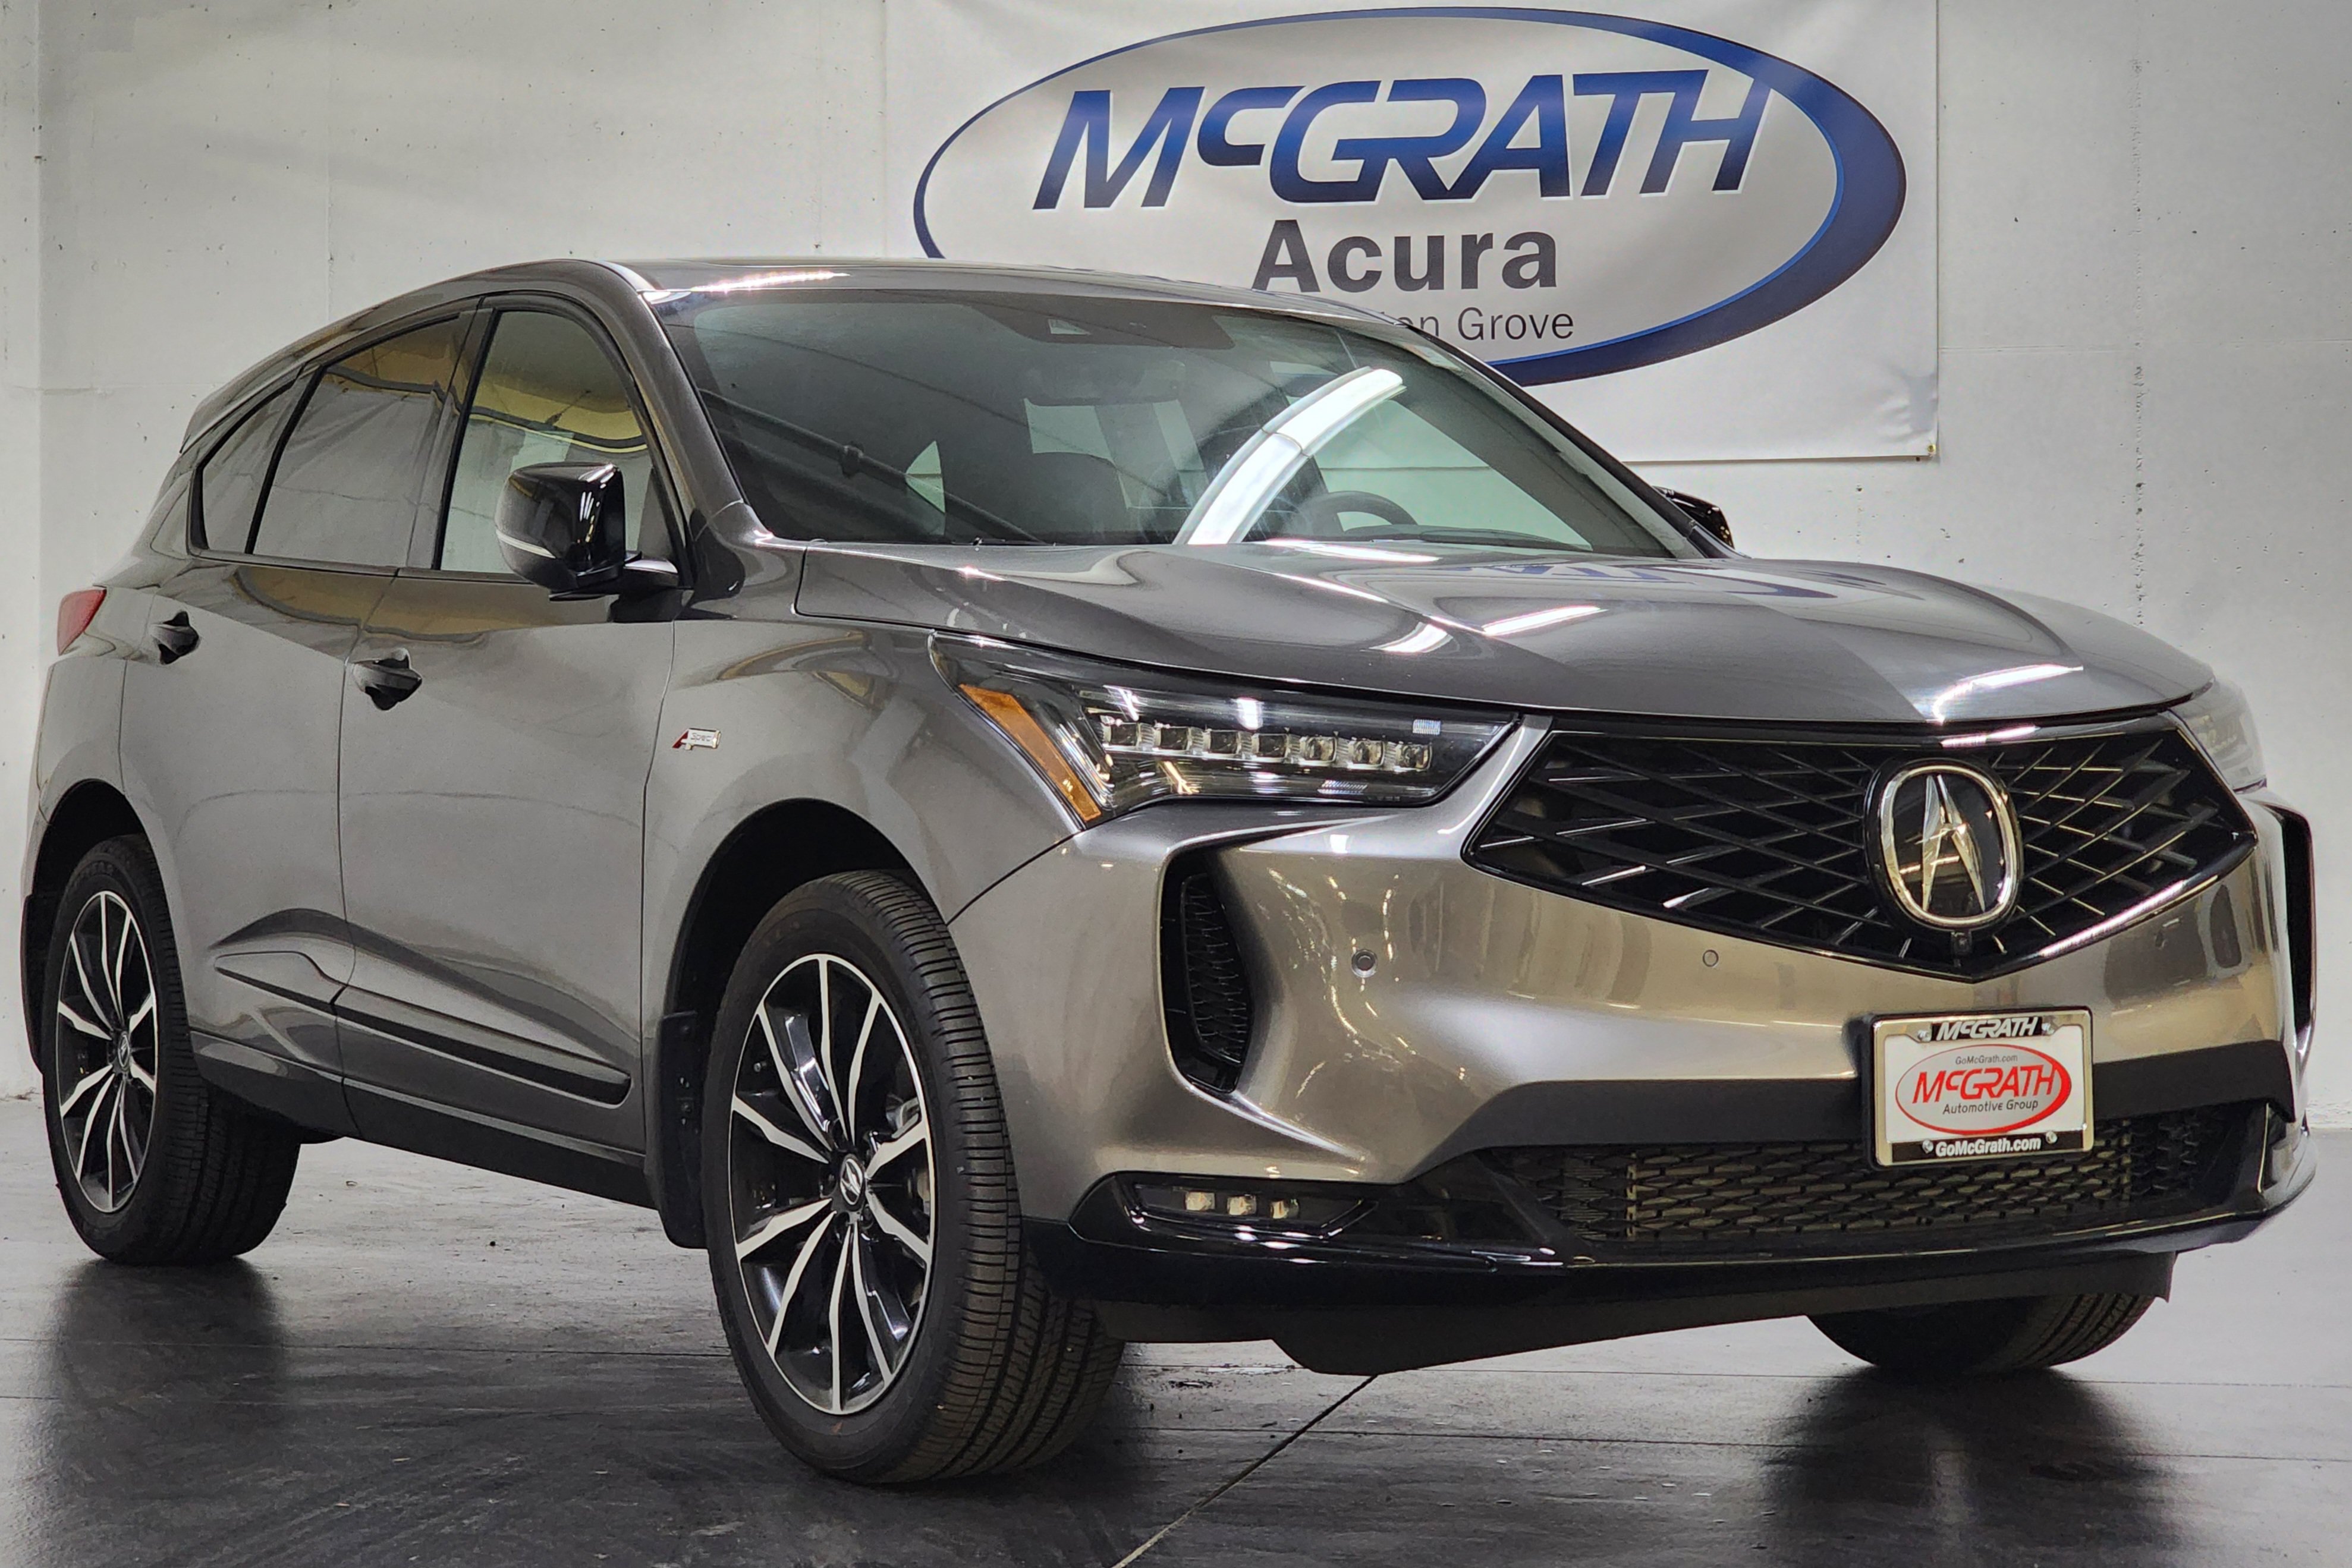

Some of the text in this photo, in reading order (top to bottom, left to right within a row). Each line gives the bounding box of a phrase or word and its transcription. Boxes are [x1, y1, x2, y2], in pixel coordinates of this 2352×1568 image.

[1252, 219, 1557, 292] Acura
[1458, 307, 1574, 341] Grove
[1955, 1054, 2018, 1065] GoMcGrath.com
[1942, 1099, 2039, 1115] Automotive Group
[1935, 1137, 2041, 1157] GoMcGrath.com
